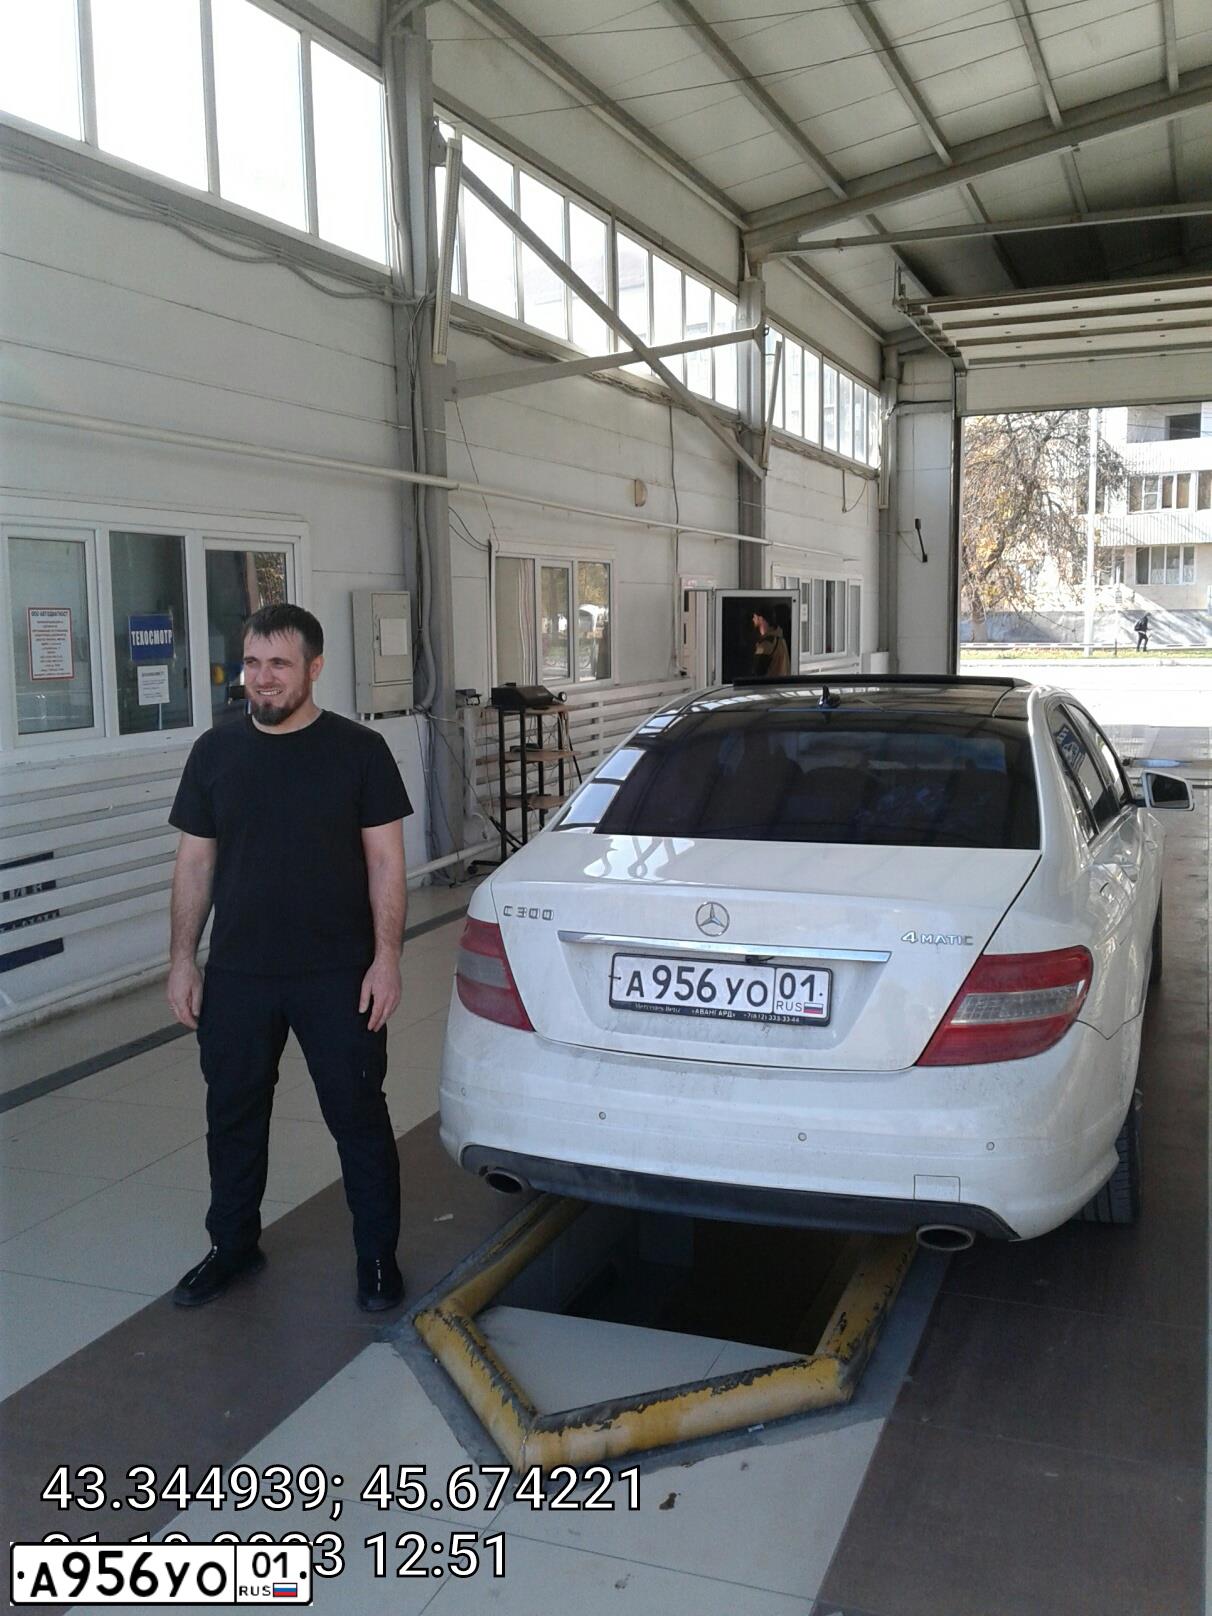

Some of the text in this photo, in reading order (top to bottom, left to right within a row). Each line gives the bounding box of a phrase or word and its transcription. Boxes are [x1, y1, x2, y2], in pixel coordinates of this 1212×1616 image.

[131, 629, 172, 646] ТЕХОСМОТР
[779, 972, 815, 1002] 01
[776, 1000, 802, 1012] RUS
